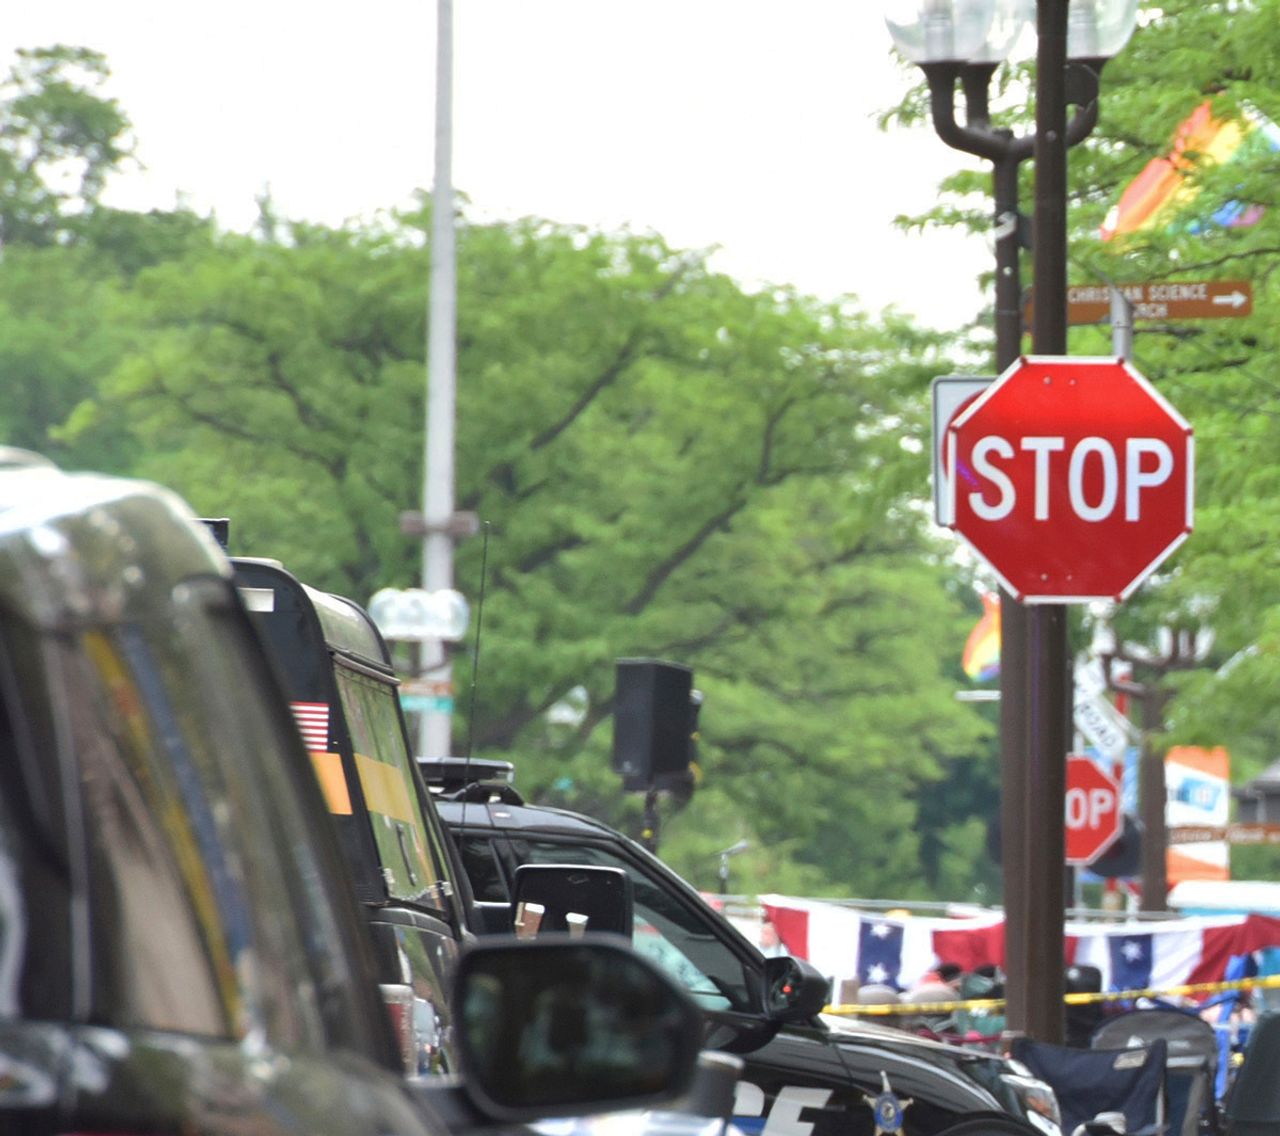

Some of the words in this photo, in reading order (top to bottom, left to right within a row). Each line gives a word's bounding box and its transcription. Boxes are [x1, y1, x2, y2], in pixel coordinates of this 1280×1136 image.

[1148, 283, 1208, 301] SCIENCE
[968, 435, 1174, 521] STOP
[1064, 787, 1114, 830] OP
